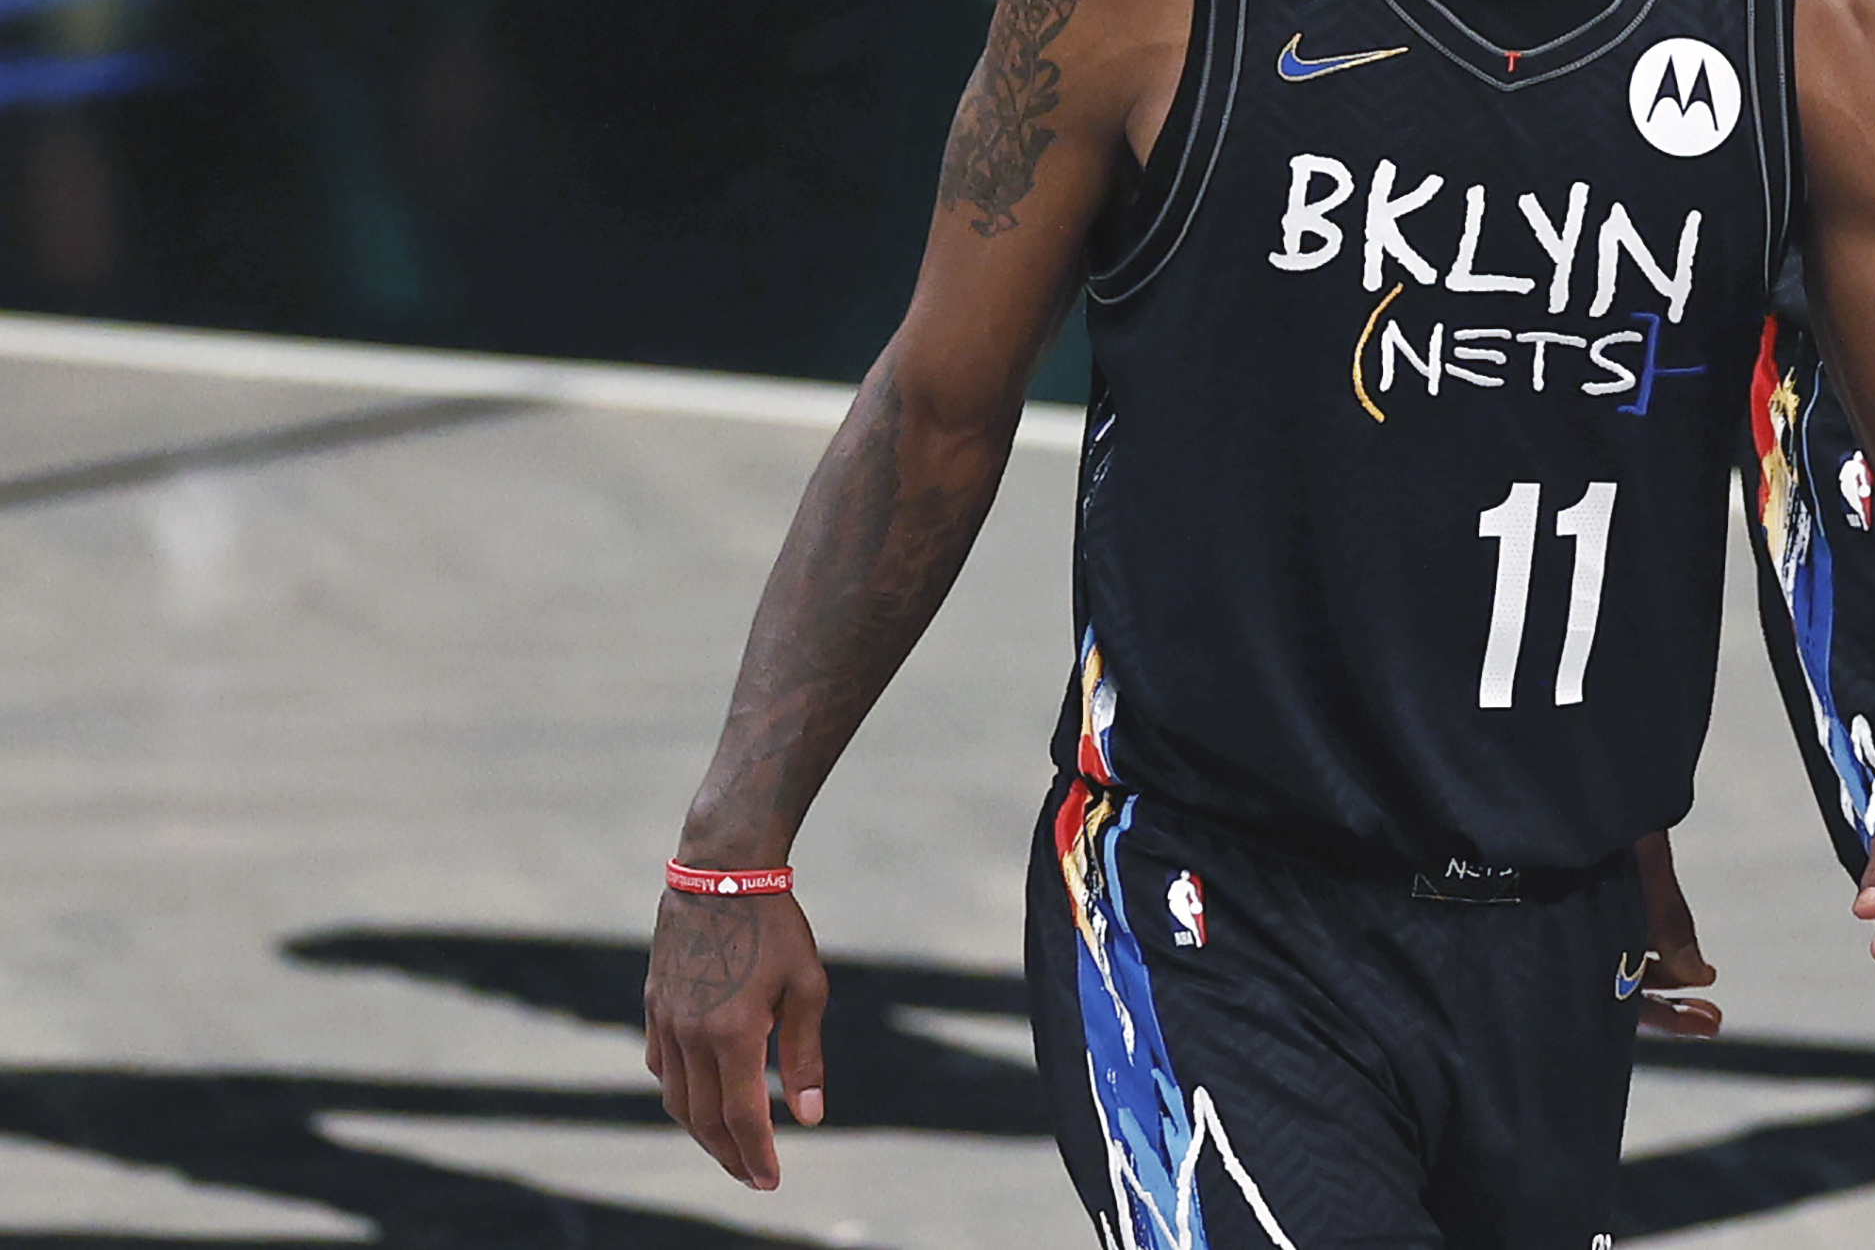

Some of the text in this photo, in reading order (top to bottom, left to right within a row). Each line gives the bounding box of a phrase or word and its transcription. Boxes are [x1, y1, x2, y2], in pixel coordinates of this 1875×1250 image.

[1268, 153, 1701, 323] BKLYN
[1479, 482, 1617, 708] 11
[742, 873, 787, 891] Bryant
